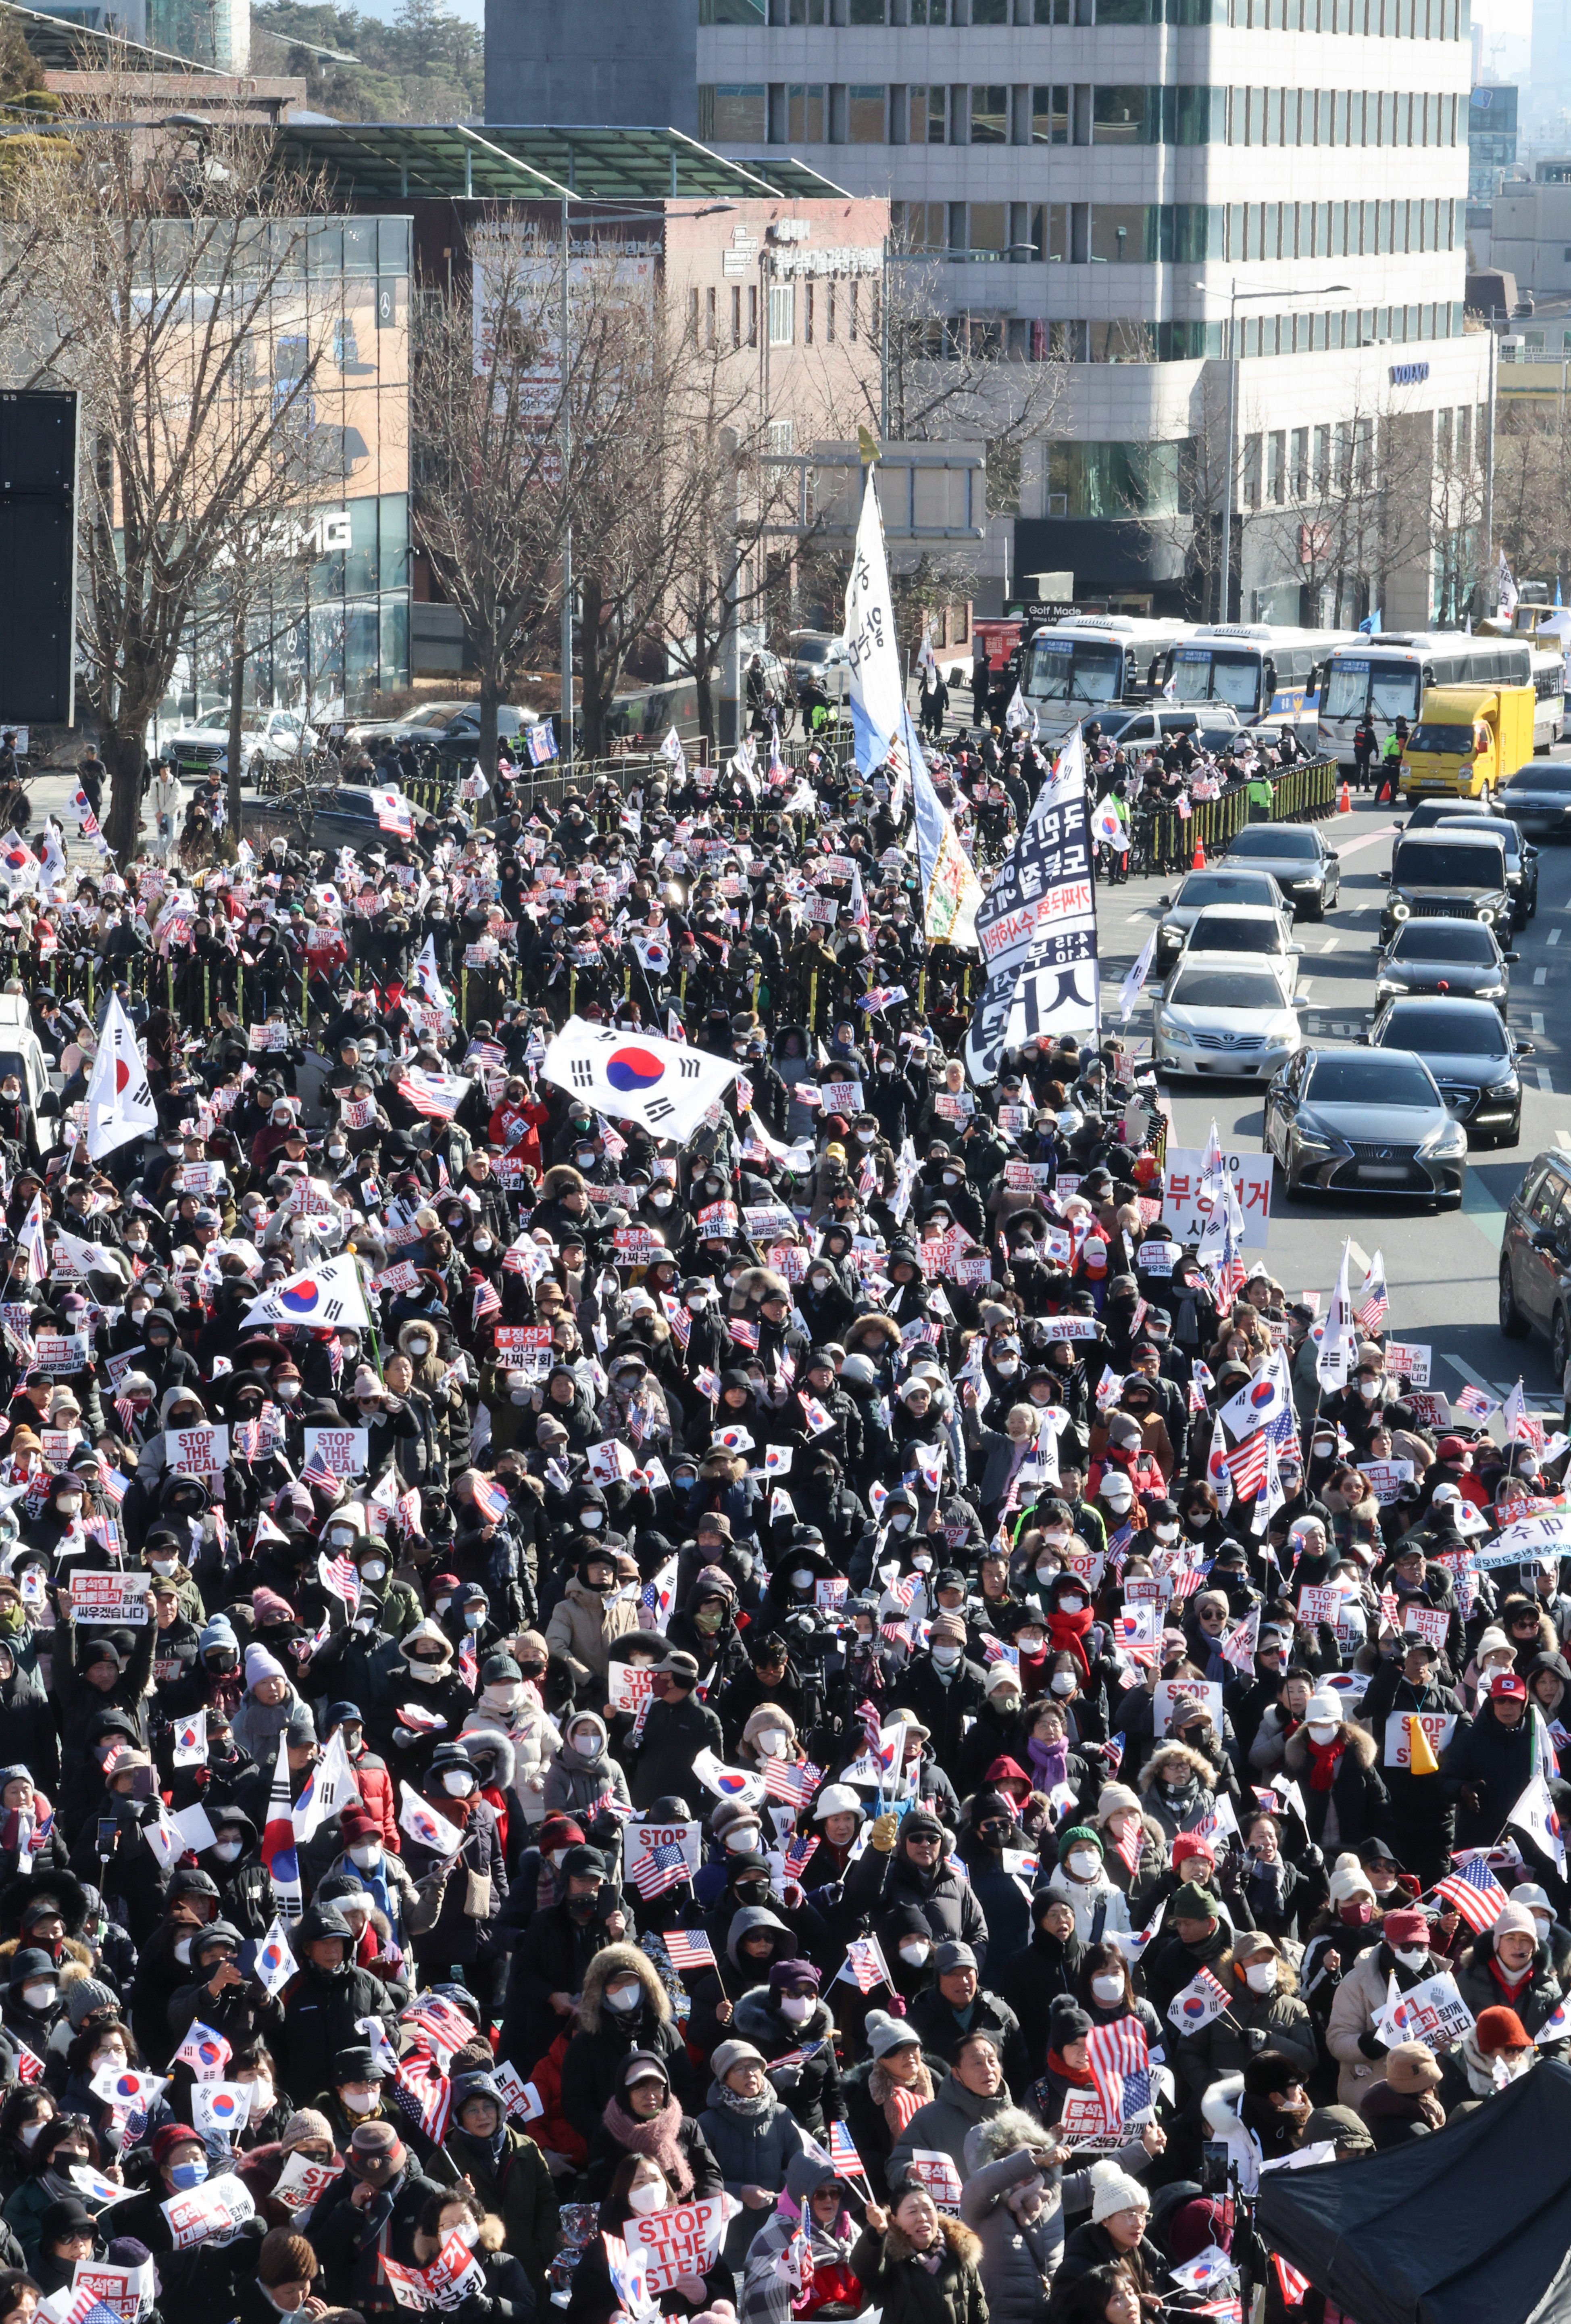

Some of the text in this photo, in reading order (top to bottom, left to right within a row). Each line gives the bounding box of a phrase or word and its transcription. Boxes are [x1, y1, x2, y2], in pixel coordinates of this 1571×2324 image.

[1394, 362, 1429, 384] VOLVO
[1029, 606, 1081, 615] Golf Made
[356, 897, 378, 907] STOP
[808, 912, 830, 921] STEAL
[420, 1011, 444, 1020] STOP
[424, 1020, 442, 1028] THE
[830, 1085, 854, 1093] STOP
[836, 1093, 853, 1101] THE
[346, 1101, 369, 1113] STOP
[350, 1111, 368, 1119] THE
[345, 1116, 372, 1127] STEAL
[298, 1189, 324, 1201] THE
[1140, 1201, 1157, 1211] STOP
[709, 1215, 729, 1223] OUT
[389, 1225, 412, 1236] STOP
[396, 1232, 413, 1241] THE
[628, 1243, 650, 1252] OUT
[920, 1246, 955, 1258] STOP
[615, 1252, 650, 1265] 가짜국
[775, 1250, 804, 1262] STOP
[927, 1256, 951, 1266] THE
[384, 1263, 408, 1279] STOP
[781, 1261, 803, 1271] THE
[389, 1272, 410, 1283] THE
[392, 1277, 419, 1291] TEAL
[1306, 1294, 1318, 1302] STOP
[497, 1328, 553, 1344] 부정선거
[1052, 1325, 1090, 1337] STEAL
[39, 1342, 65, 1352] 윤석열
[512, 1343, 536, 1353] OUT
[39, 1351, 73, 1362] 대통령과
[1413, 1364, 1427, 1372] 함께
[1404, 1395, 1436, 1406] STOP
[1414, 1413, 1446, 1425] TEAL
[43, 1437, 68, 1449] 윤석열
[178, 1431, 215, 1447] STOP
[317, 1433, 355, 1446] STOP
[185, 1446, 210, 1459] THE
[324, 1446, 351, 1459] THE
[176, 1459, 221, 1473] STEAL
[75, 1578, 110, 1590] 윤석열
[822, 1582, 846, 1592] STOP
[76, 1591, 144, 1604] 대통령과 함께
[827, 1592, 844, 1602] THE
[1308, 1590, 1337, 1600] STOP
[1456, 1590, 1475, 1601] TOP
[1312, 1601, 1332, 1611] THE
[78, 1607, 144, 1619] 싸우겠습니다
[1301, 1611, 1335, 1623] STEAL
[1410, 1610, 1446, 1622] STEAL
[629, 1684, 651, 1696] TH
[1167, 1684, 1210, 1700] STOP
[639, 1829, 687, 1845] STOP
[1437, 2001, 1464, 2019] 함께
[1123, 2123, 1147, 2135] 함께
[917, 2163, 958, 2182] 윤석열
[228, 2200, 252, 2222] 함께
[638, 2205, 712, 2243] STOP
[650, 2230, 706, 2262] THE
[646, 2251, 715, 2292] STEAL
